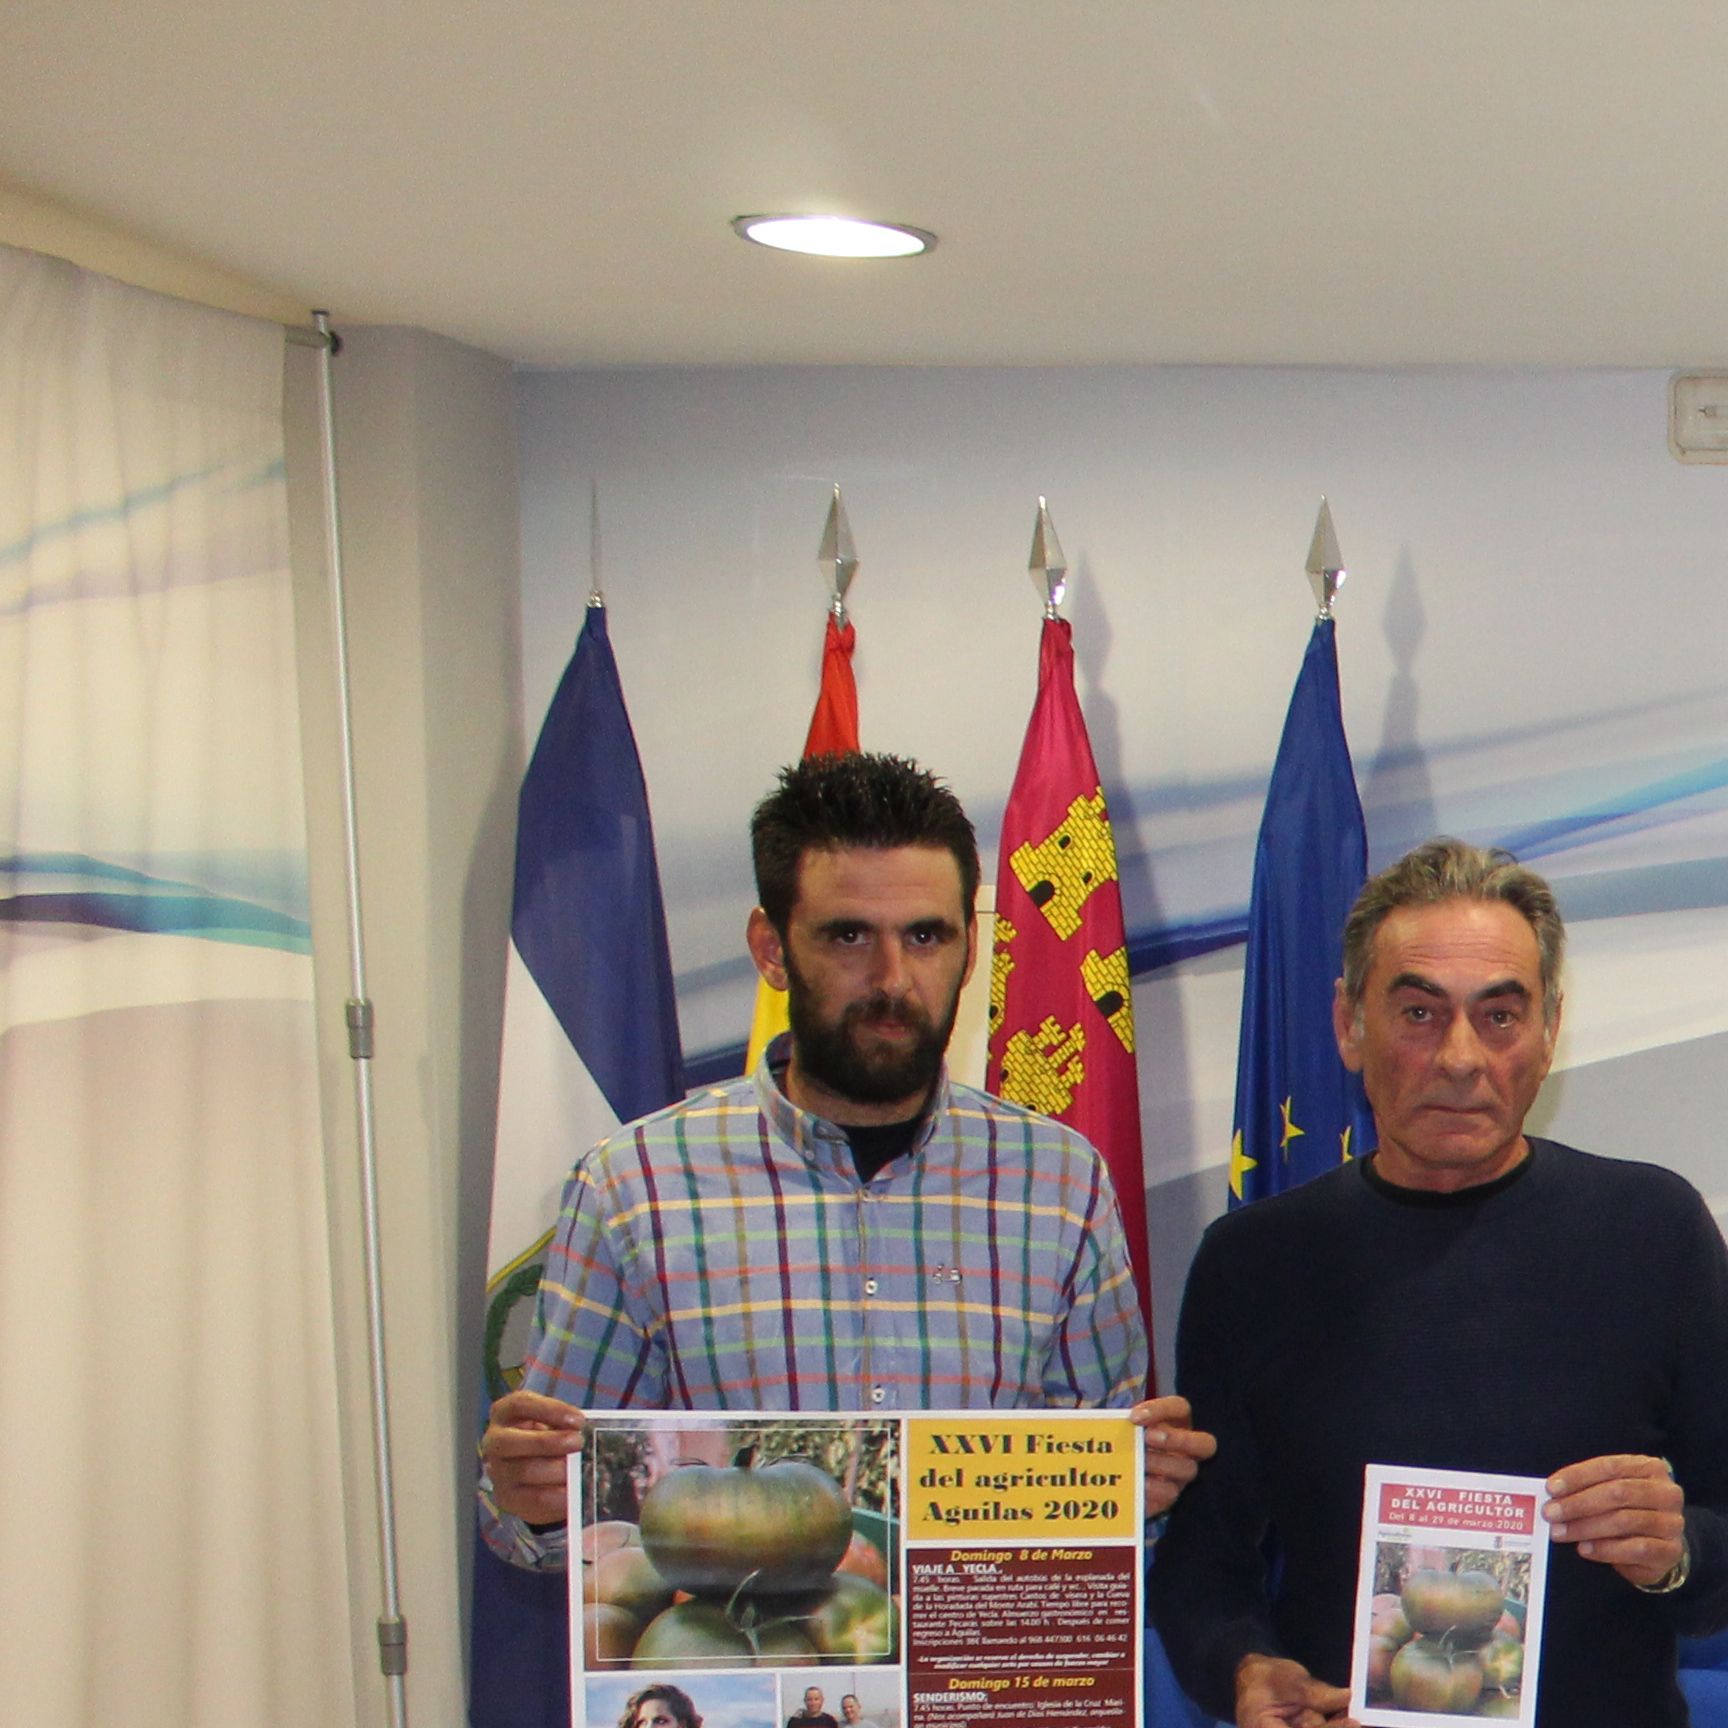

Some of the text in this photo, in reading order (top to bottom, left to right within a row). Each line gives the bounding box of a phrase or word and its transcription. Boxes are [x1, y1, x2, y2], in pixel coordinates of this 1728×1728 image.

[931, 1434, 1112, 1454] XXVI Fiesta
[920, 1468, 1121, 1492] del agricultor
[1405, 1487, 1512, 1505] XXVI FIESTA
[923, 1500, 1118, 1526] Aguilas 2020
[1391, 1499, 1524, 1518] DEL AGRICULTOR
[1497, 1521, 1523, 1530] 2020
[951, 1549, 1093, 1563] Domingo 8 de Marzo
[949, 1677, 1094, 1691] Domingo 15 de marzo
